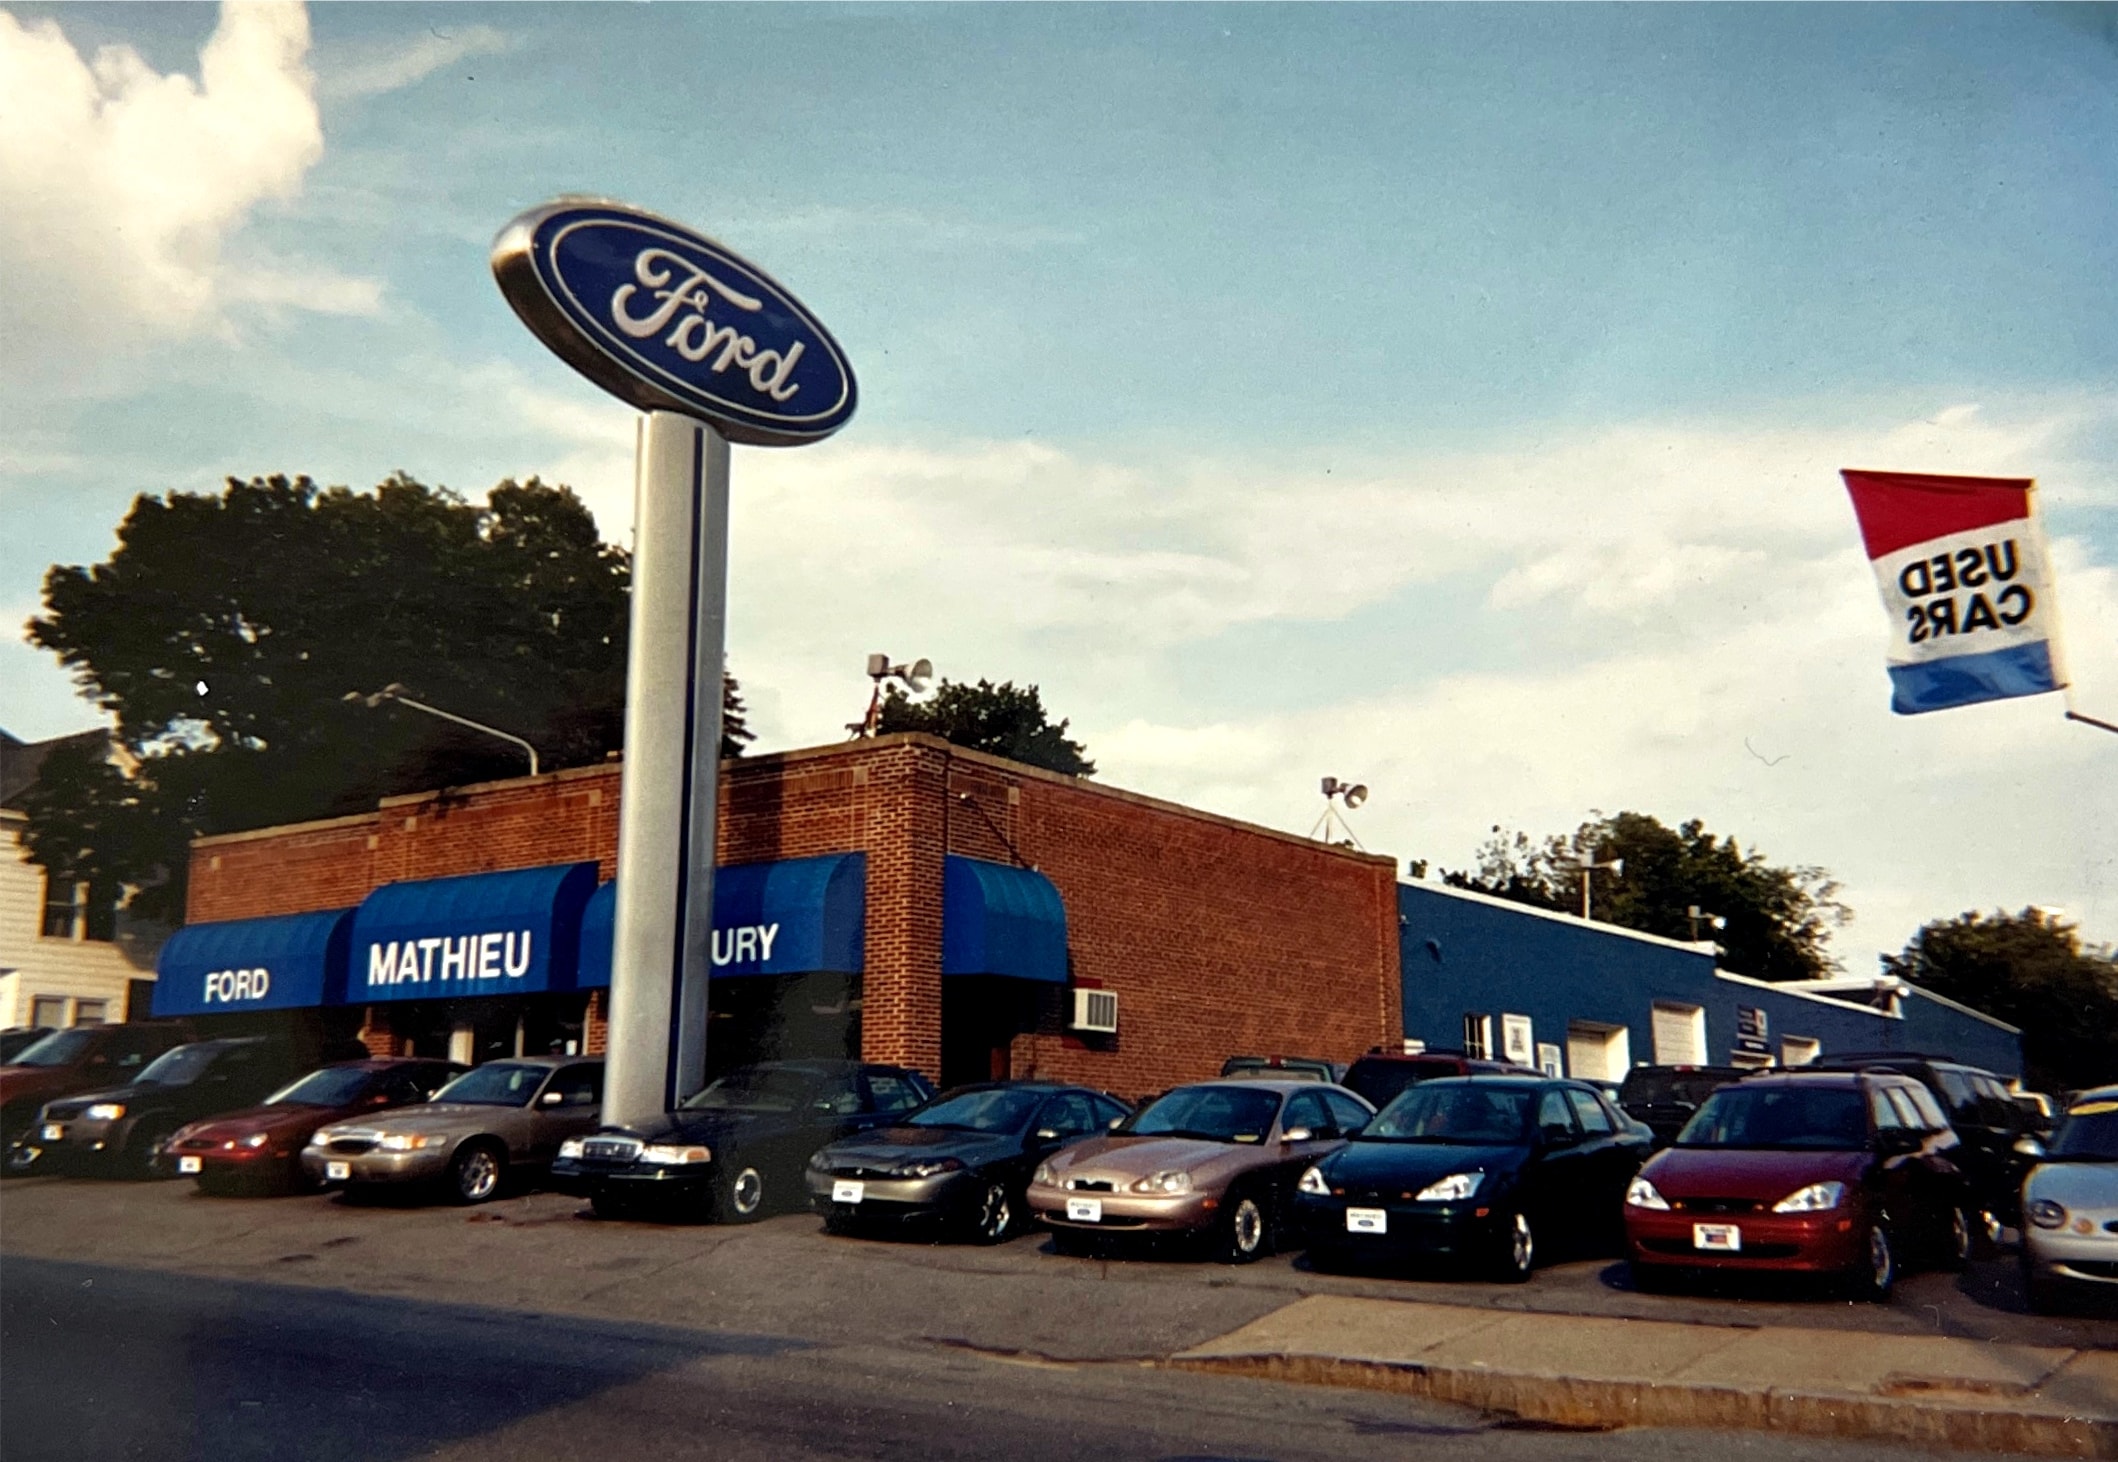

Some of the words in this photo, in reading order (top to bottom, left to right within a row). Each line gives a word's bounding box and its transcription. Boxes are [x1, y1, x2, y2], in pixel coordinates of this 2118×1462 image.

[611, 248, 804, 400] Ford
[203, 967, 269, 1003] FORD
[368, 930, 531, 986] MATHIEU
